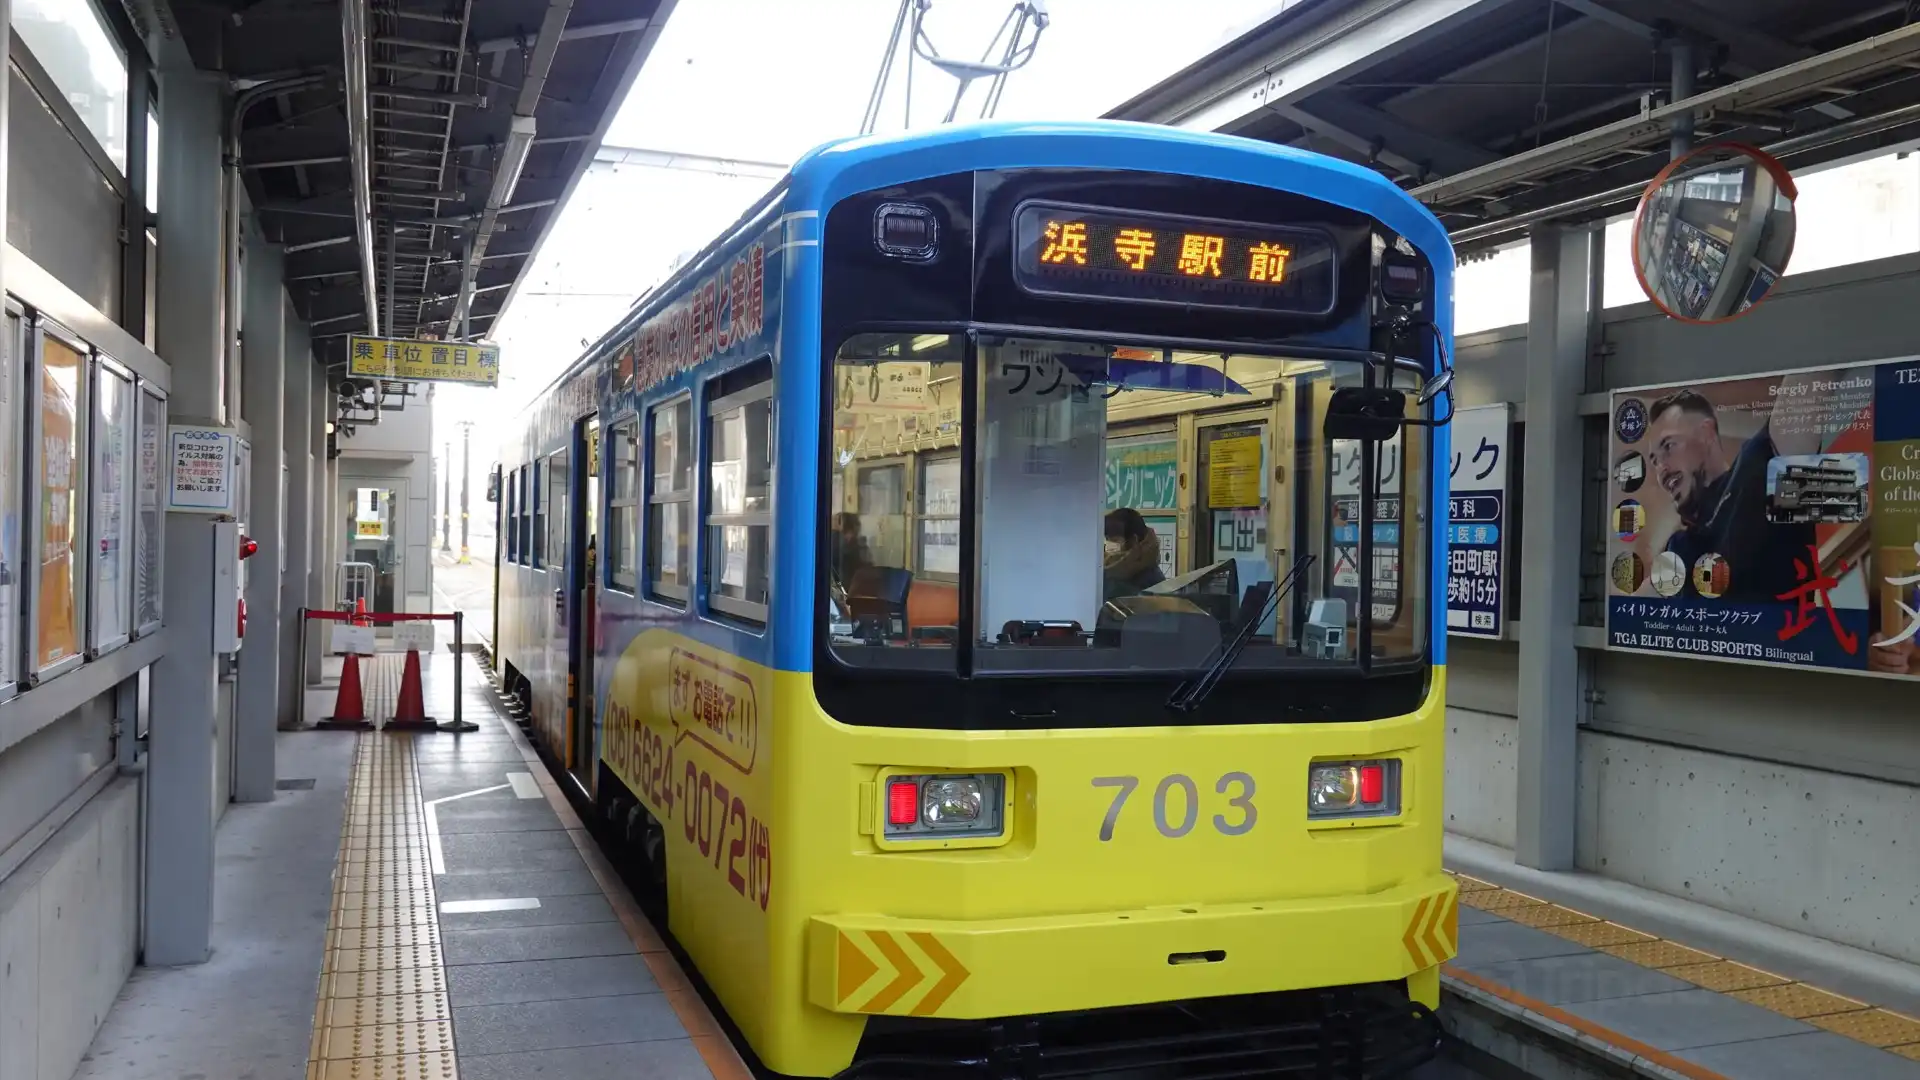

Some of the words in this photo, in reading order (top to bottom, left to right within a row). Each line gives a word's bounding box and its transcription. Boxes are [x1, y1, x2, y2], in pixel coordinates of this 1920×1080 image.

[1041, 220, 1290, 283] 浜寺駅前
[354, 341, 497, 368] 乗車位置目標
[1768, 383, 1809, 397] Sergiy
[1811, 376, 1872, 392] Petrenko
[1895, 368, 1920, 385] TE
[1884, 488, 1901, 502] of
[1775, 544, 1858, 655] 武
[1616, 602, 1682, 619] バイリンガル
[1685, 606, 1763, 626] スポーツクラブ
[1643, 620, 1671, 631] Toddler
[1675, 623, 1695, 632] Adult
[1614, 631, 1638, 645] TGA
[1640, 634, 1674, 649] ELITE
[1676, 637, 1709, 651] CLUB
[1711, 640, 1763, 657] SPORTS
[1765, 647, 1814, 662] Bilingual
[1091, 771, 1258, 842] 703
